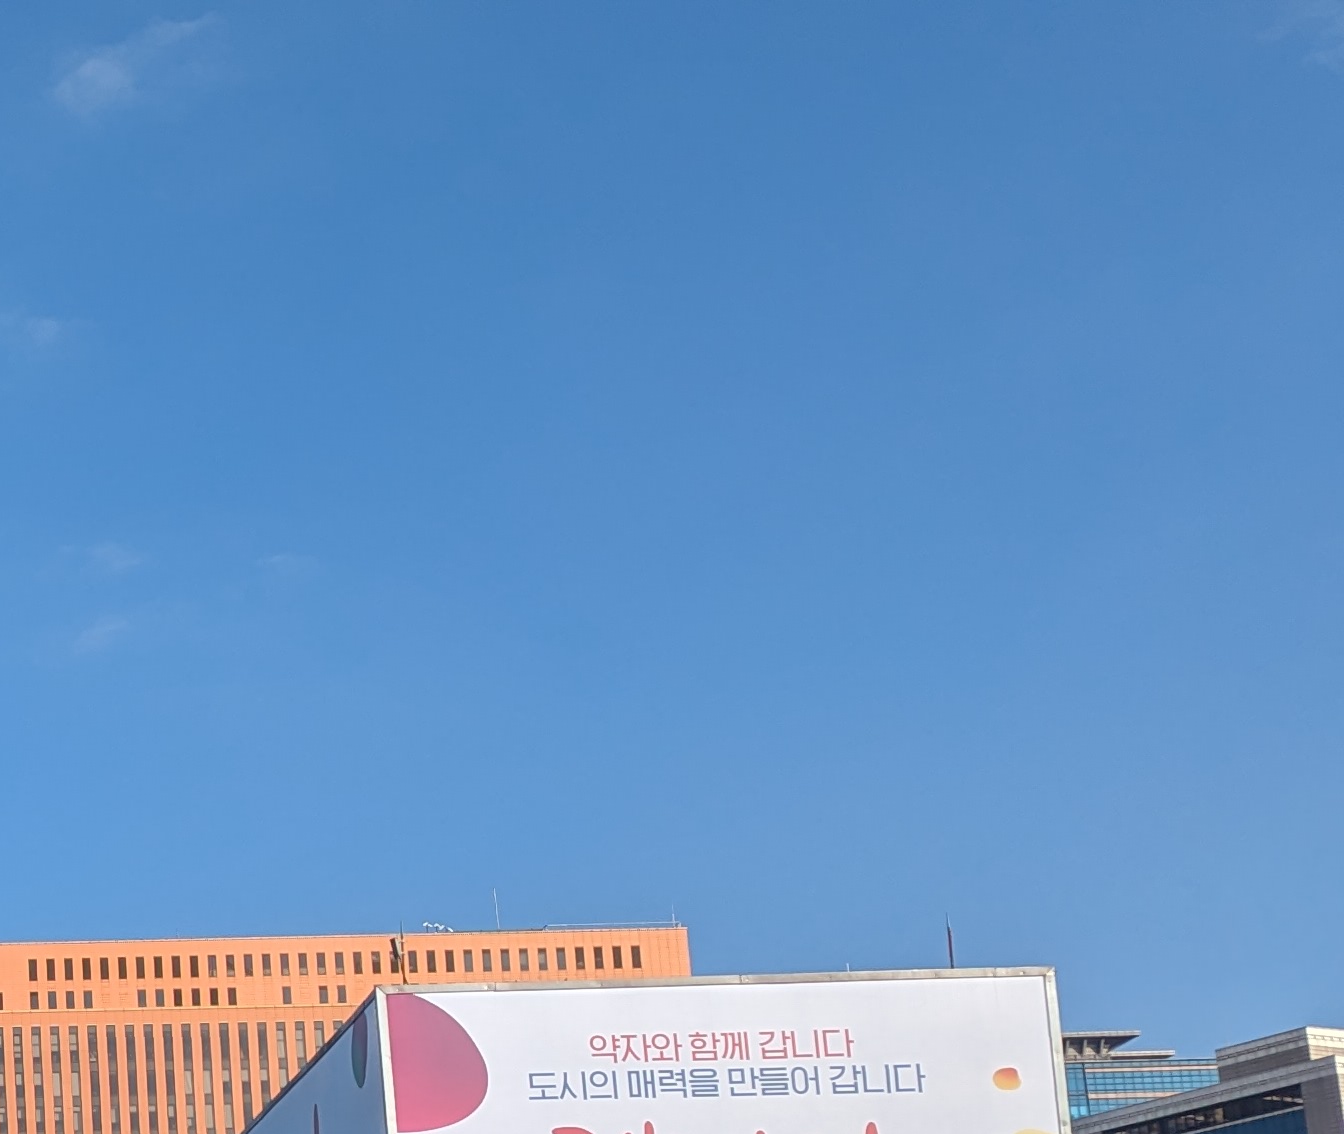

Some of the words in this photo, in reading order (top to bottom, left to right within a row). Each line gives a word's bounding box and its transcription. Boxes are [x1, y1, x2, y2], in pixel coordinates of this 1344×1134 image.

[589, 1032, 682, 1064] 약자와
[688, 1030, 751, 1062] 함께
[758, 1027, 855, 1060] 갑니다
[527, 1069, 619, 1101] 도시의
[626, 1066, 721, 1099] 매력을
[727, 1065, 820, 1097] 만들어
[828, 1062, 927, 1095] 갑니다
